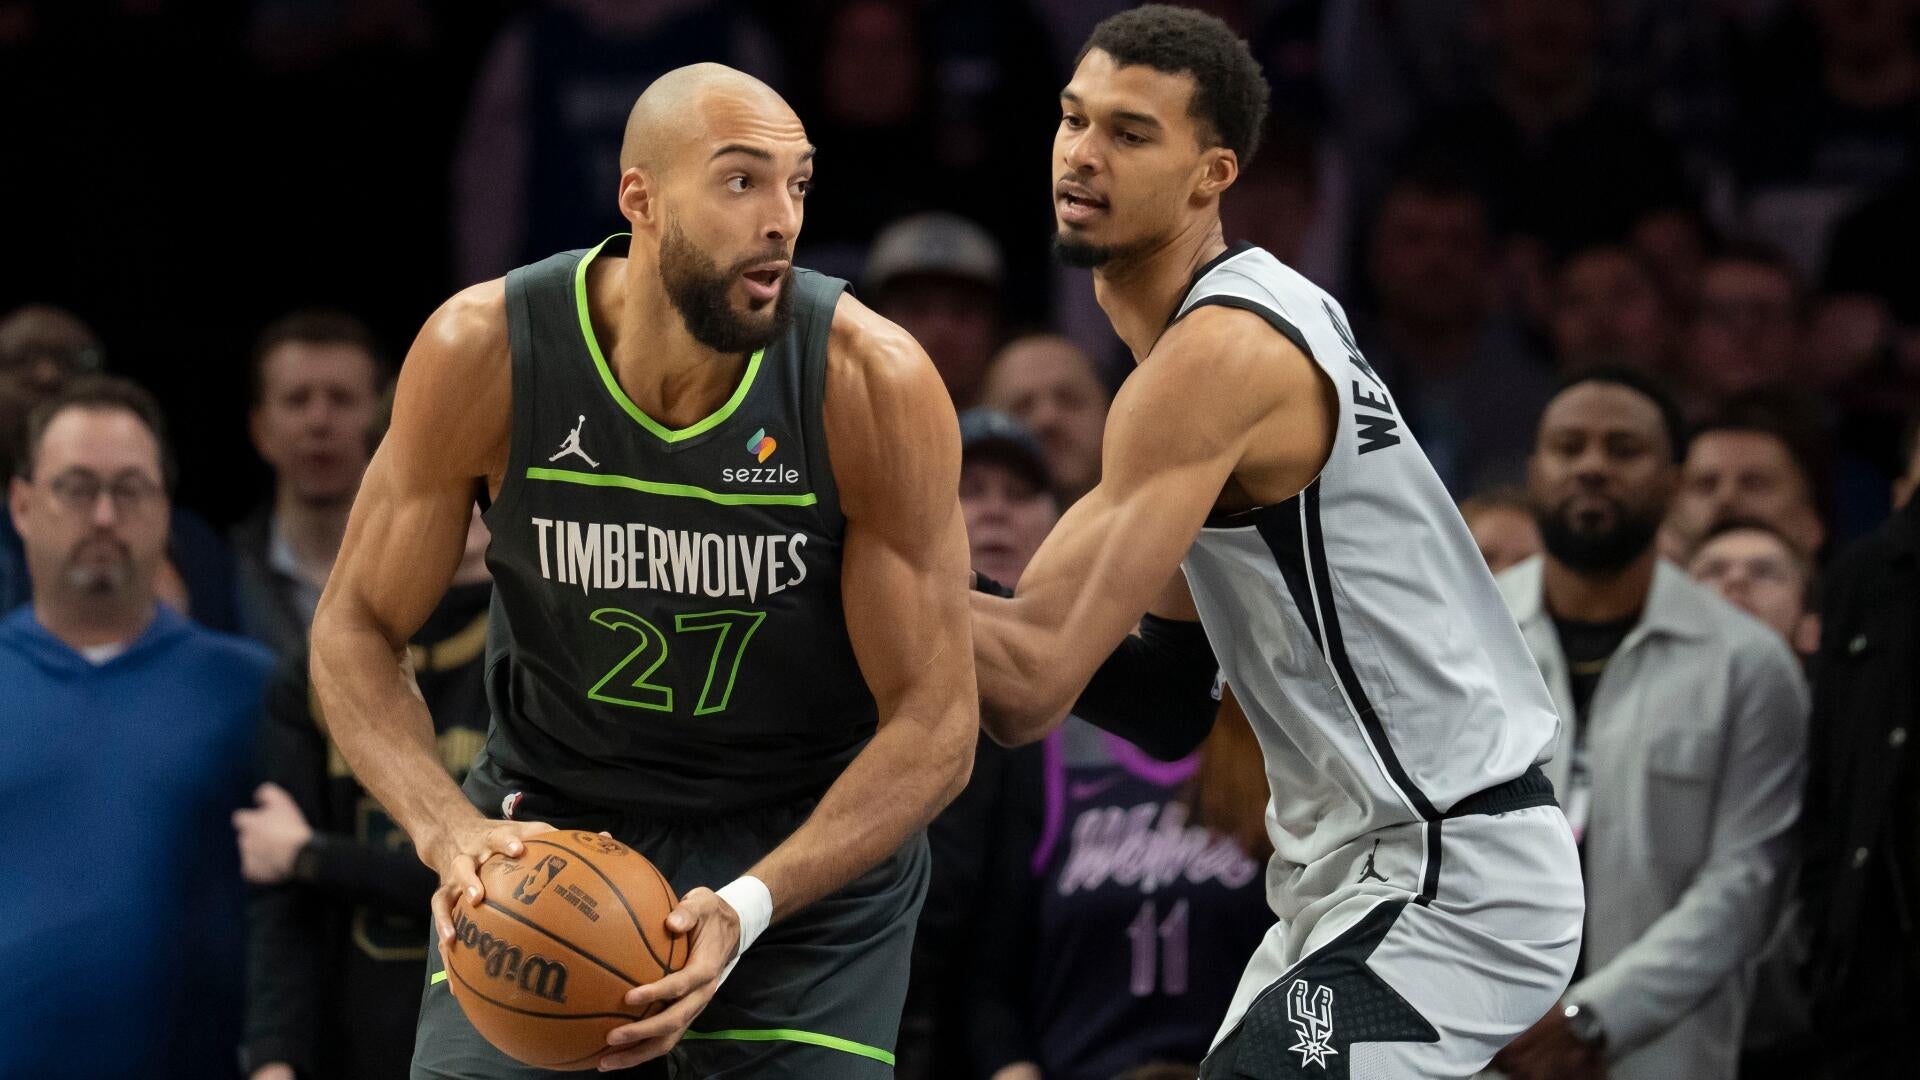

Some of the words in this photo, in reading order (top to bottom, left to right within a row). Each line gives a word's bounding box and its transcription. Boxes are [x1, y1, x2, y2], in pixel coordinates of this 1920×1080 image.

[722, 463, 799, 484] sezzle
[531, 516, 808, 604] TIMBERWOLVES
[587, 606, 767, 716] 27
[453, 910, 568, 1004] Wilson
[1127, 898, 1190, 996] 11
